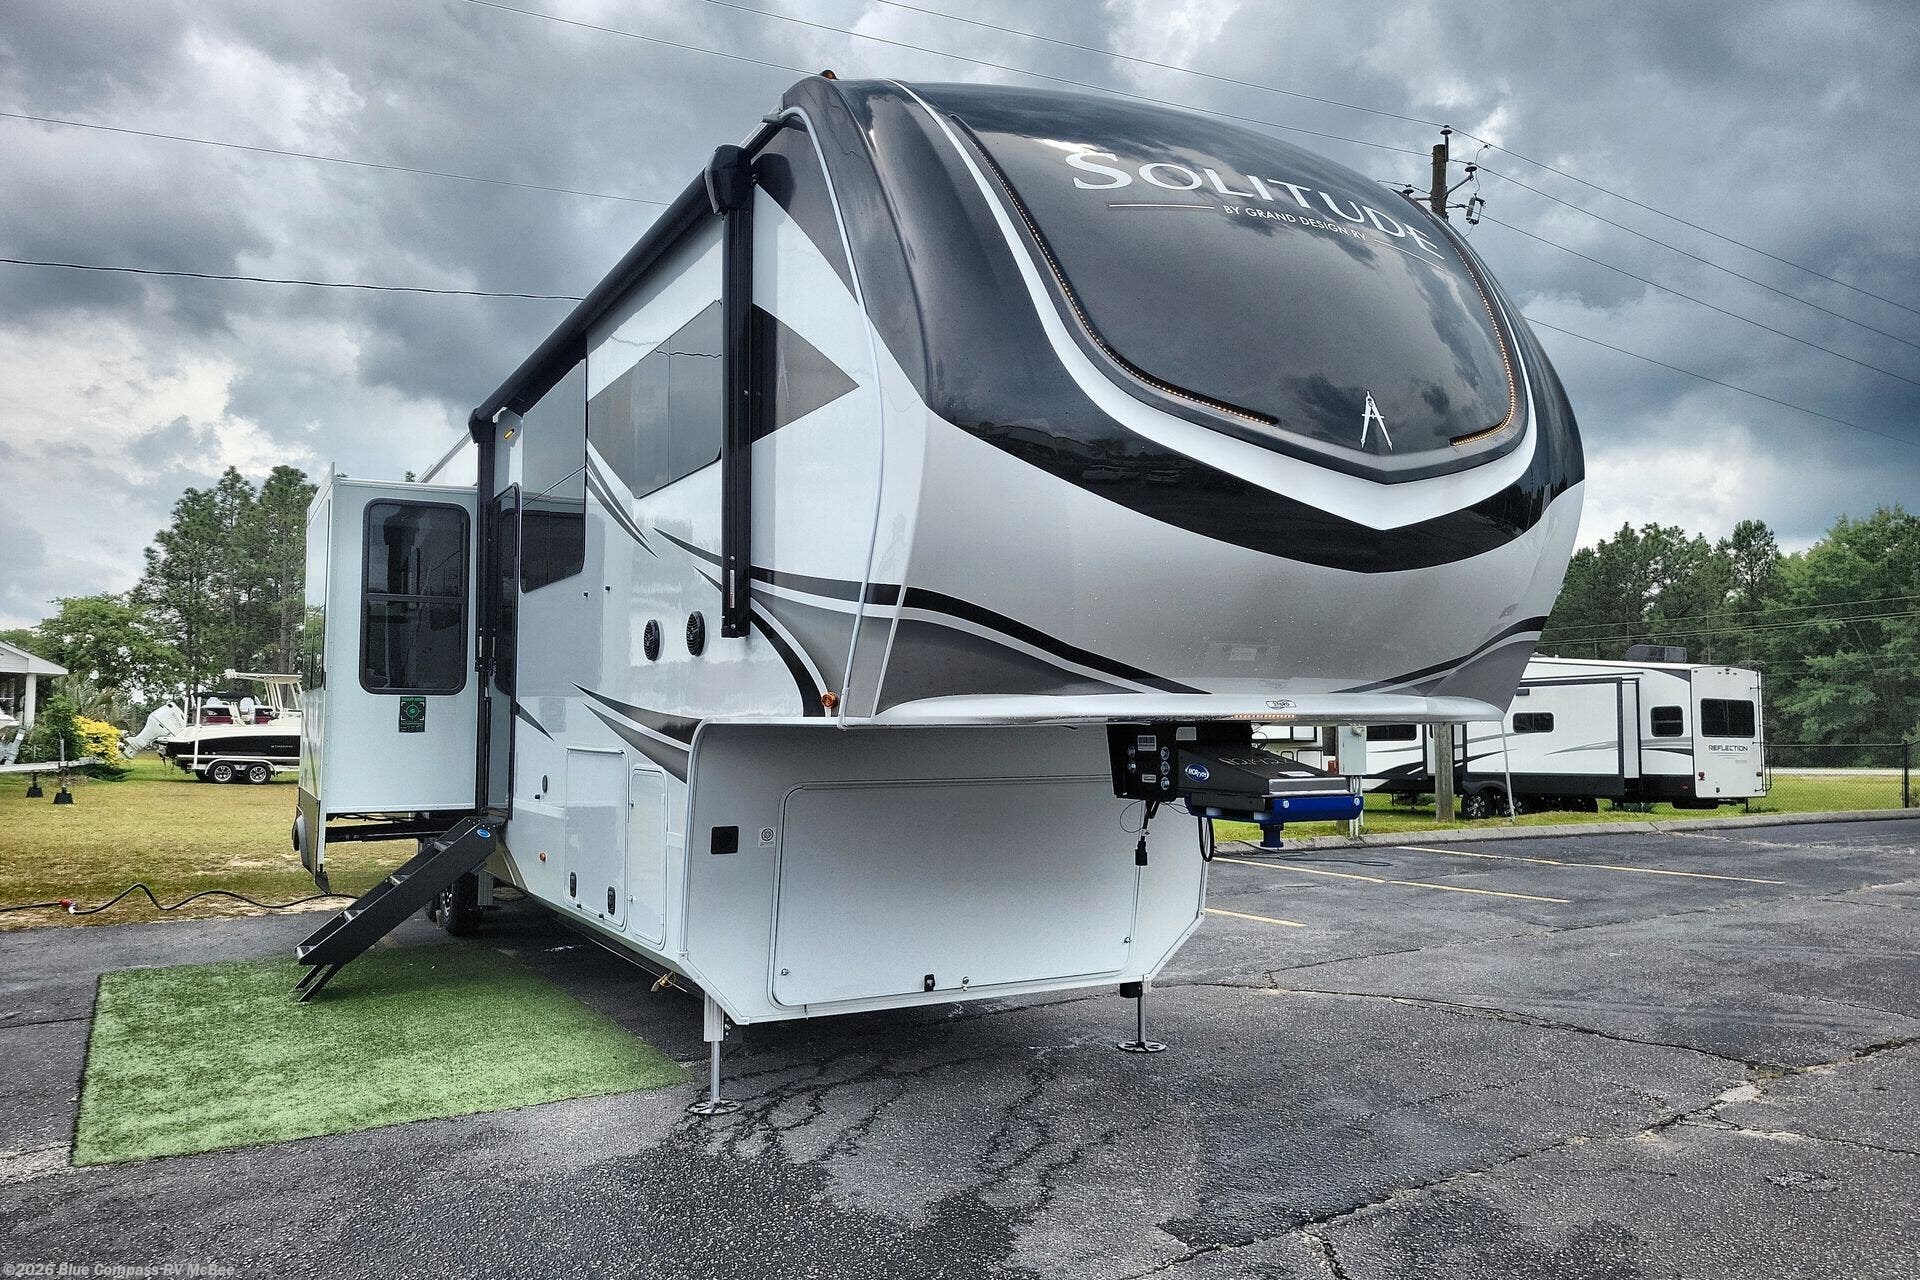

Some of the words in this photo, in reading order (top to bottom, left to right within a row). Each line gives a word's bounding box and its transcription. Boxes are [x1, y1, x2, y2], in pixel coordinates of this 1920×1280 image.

[1065, 152, 1444, 260] SOLITUDE
[1222, 204, 1240, 216] BY
[1245, 207, 1296, 223] GRAND
[1299, 215, 1350, 236] DESIGN
[1349, 228, 1367, 241] RV
[1707, 744, 1749, 752] REFLECTION
